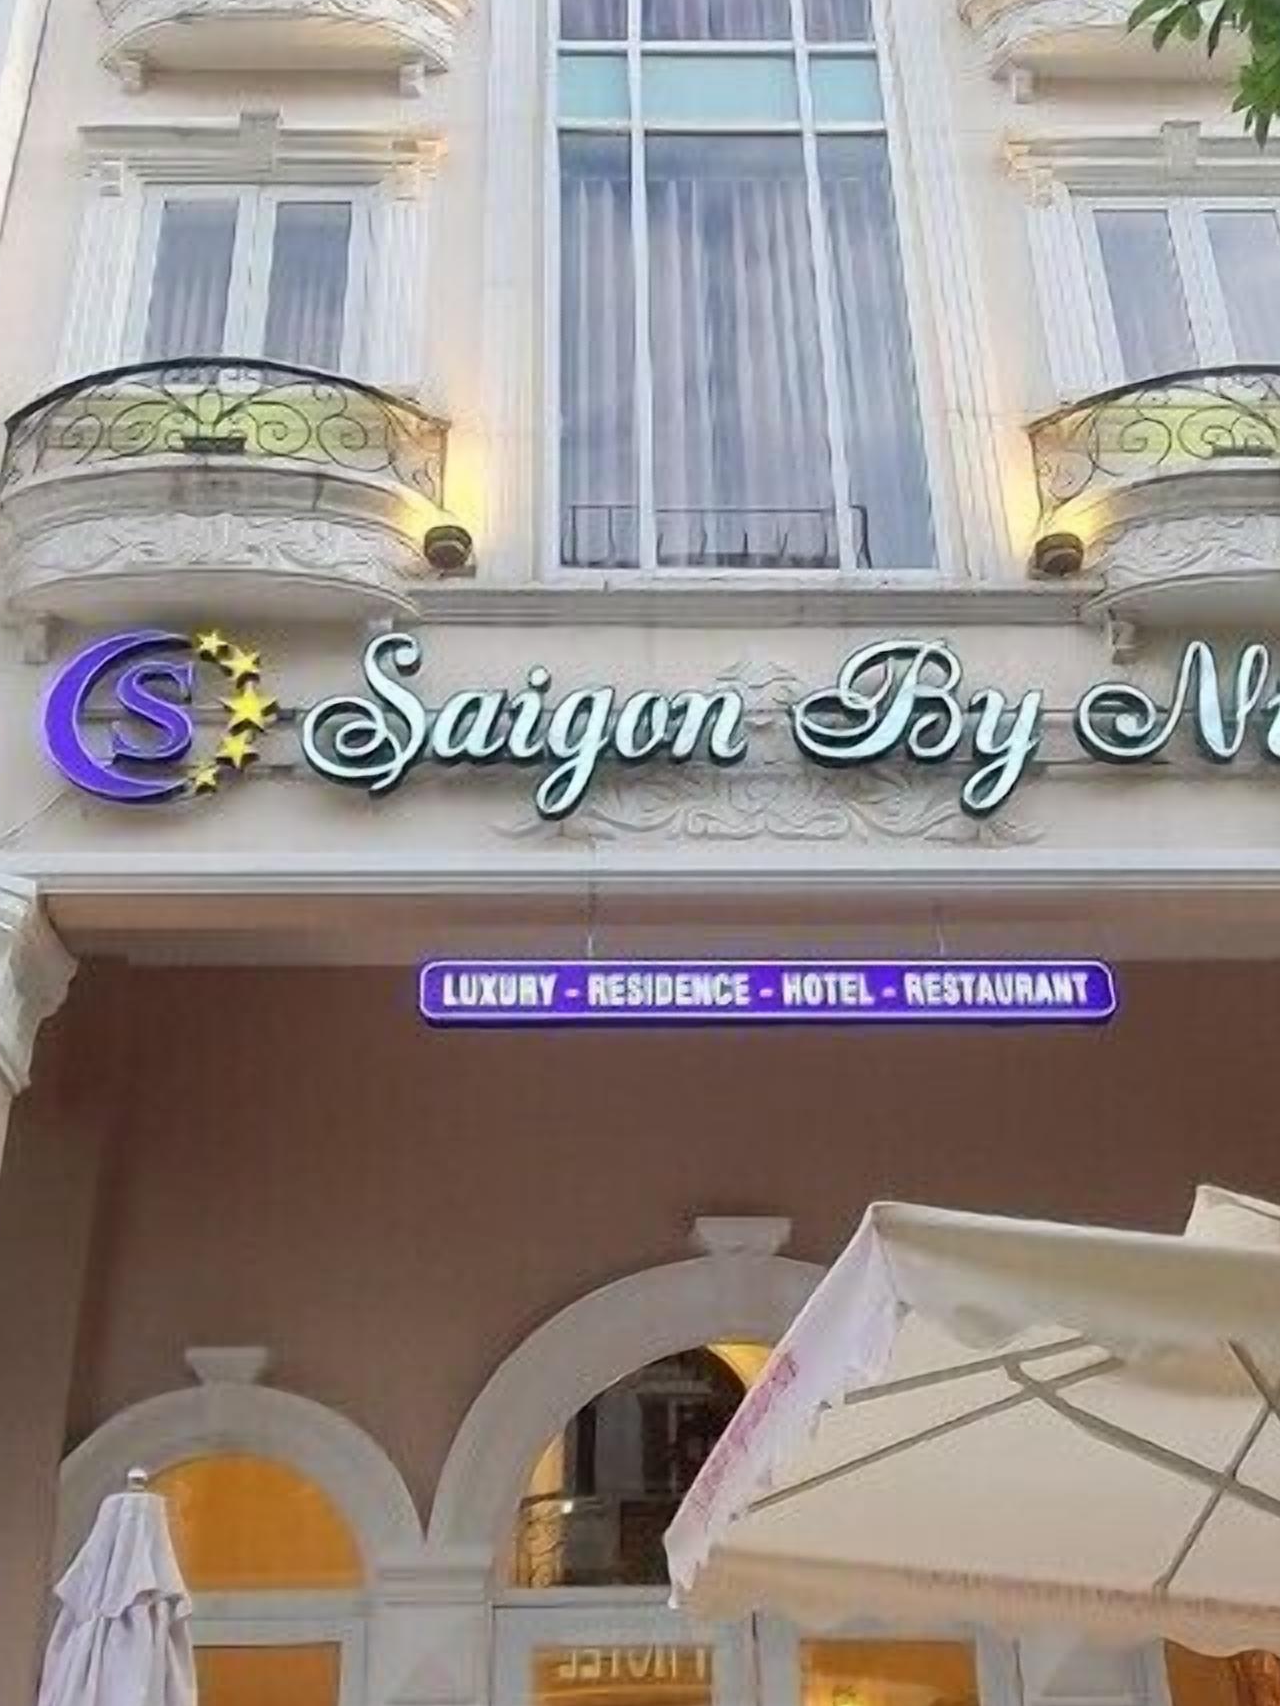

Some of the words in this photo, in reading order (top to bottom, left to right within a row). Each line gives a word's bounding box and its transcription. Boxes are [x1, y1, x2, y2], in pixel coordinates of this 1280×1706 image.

[300, 632, 750, 821] Saigon
[792, 639, 1042, 817] By
[442, 973, 558, 1006] LUXURY
[587, 973, 751, 1006] RESIDENCE
[781, 973, 875, 1006] HOTEL
[903, 973, 1089, 1006] RESTAURANT
